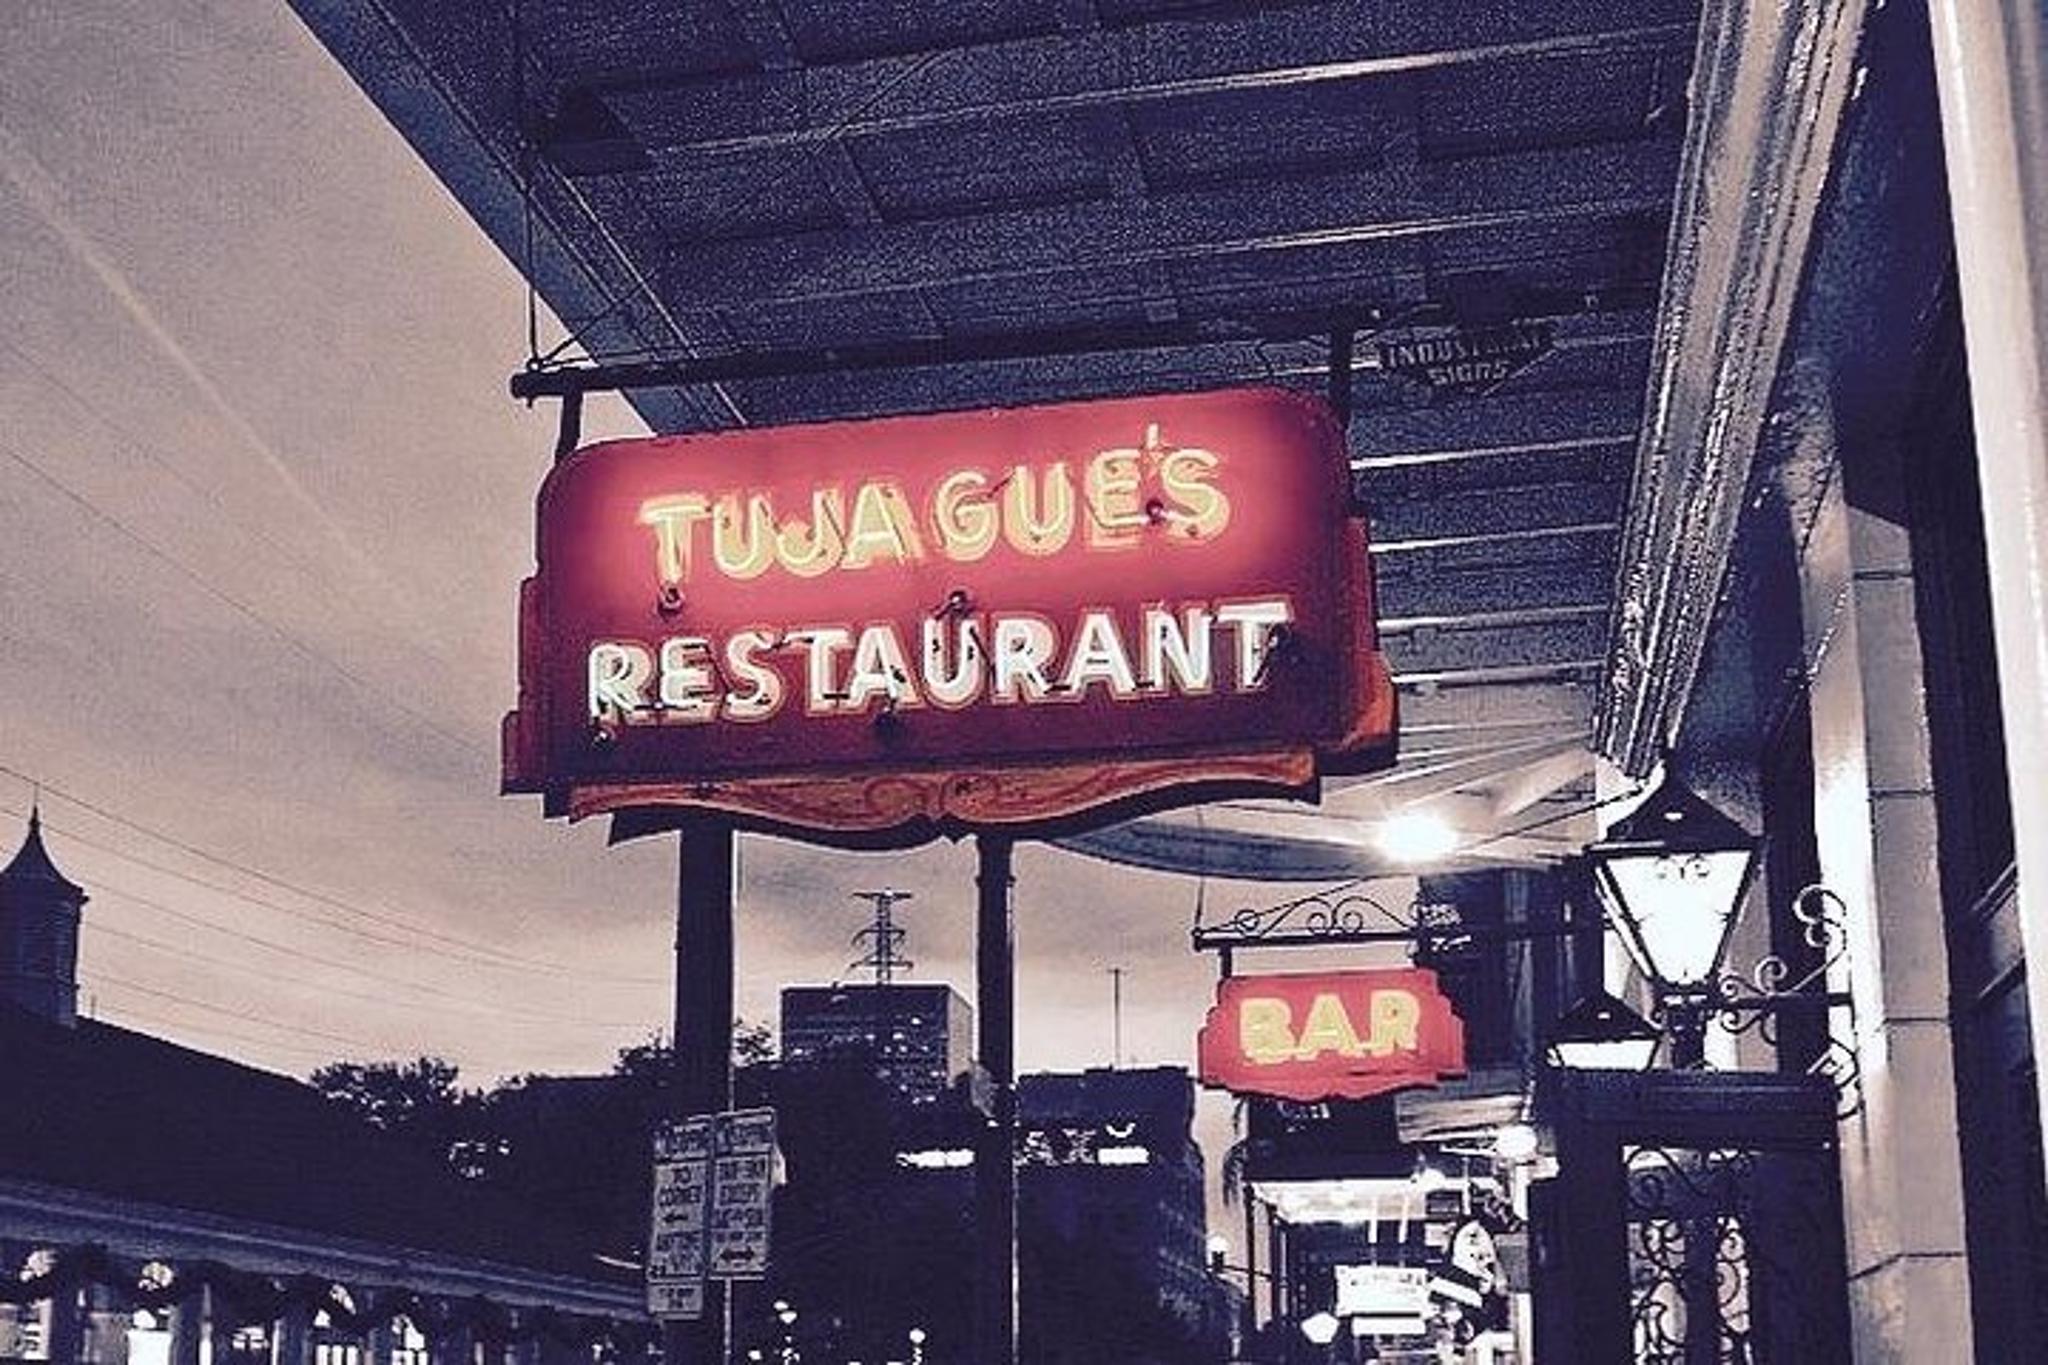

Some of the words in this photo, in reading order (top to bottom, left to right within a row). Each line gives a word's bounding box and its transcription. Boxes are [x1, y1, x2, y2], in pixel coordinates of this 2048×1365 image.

[1387, 334, 1542, 368] INDUST
[640, 423, 1232, 582] TUJAGUE'S
[587, 595, 1294, 728] RESTAURANT
[1240, 989, 1421, 1066] BAR
